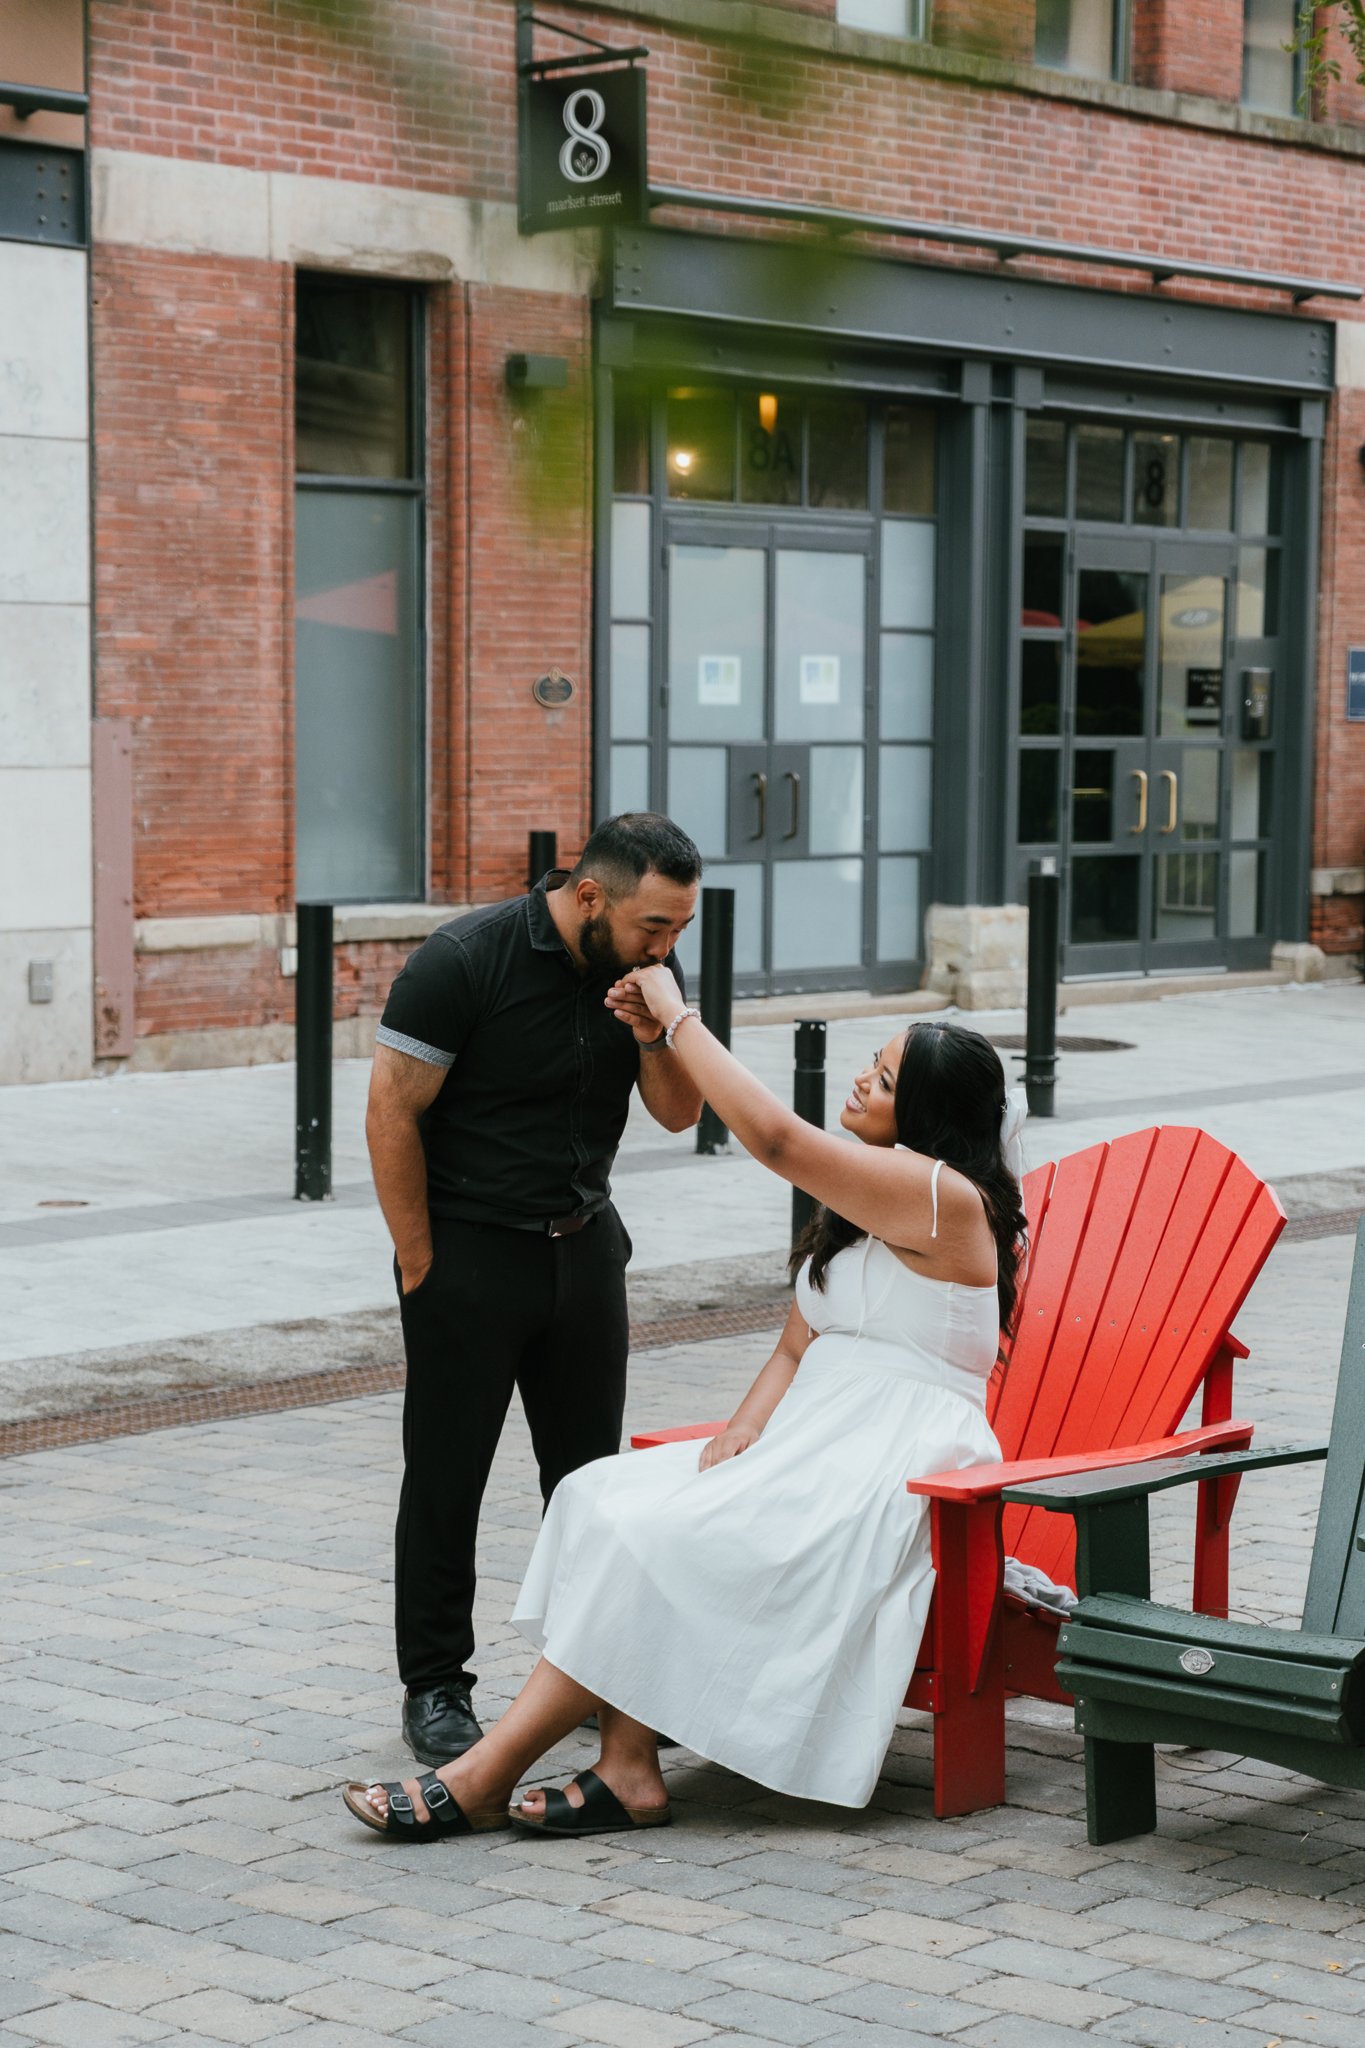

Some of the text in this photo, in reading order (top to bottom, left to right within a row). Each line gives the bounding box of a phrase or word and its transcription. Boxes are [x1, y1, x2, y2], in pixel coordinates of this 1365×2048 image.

[559, 88, 611, 183] 8
[546, 191, 622, 213] market street
[749, 427, 796, 473] 8A
[1145, 459, 1164, 507] 8
